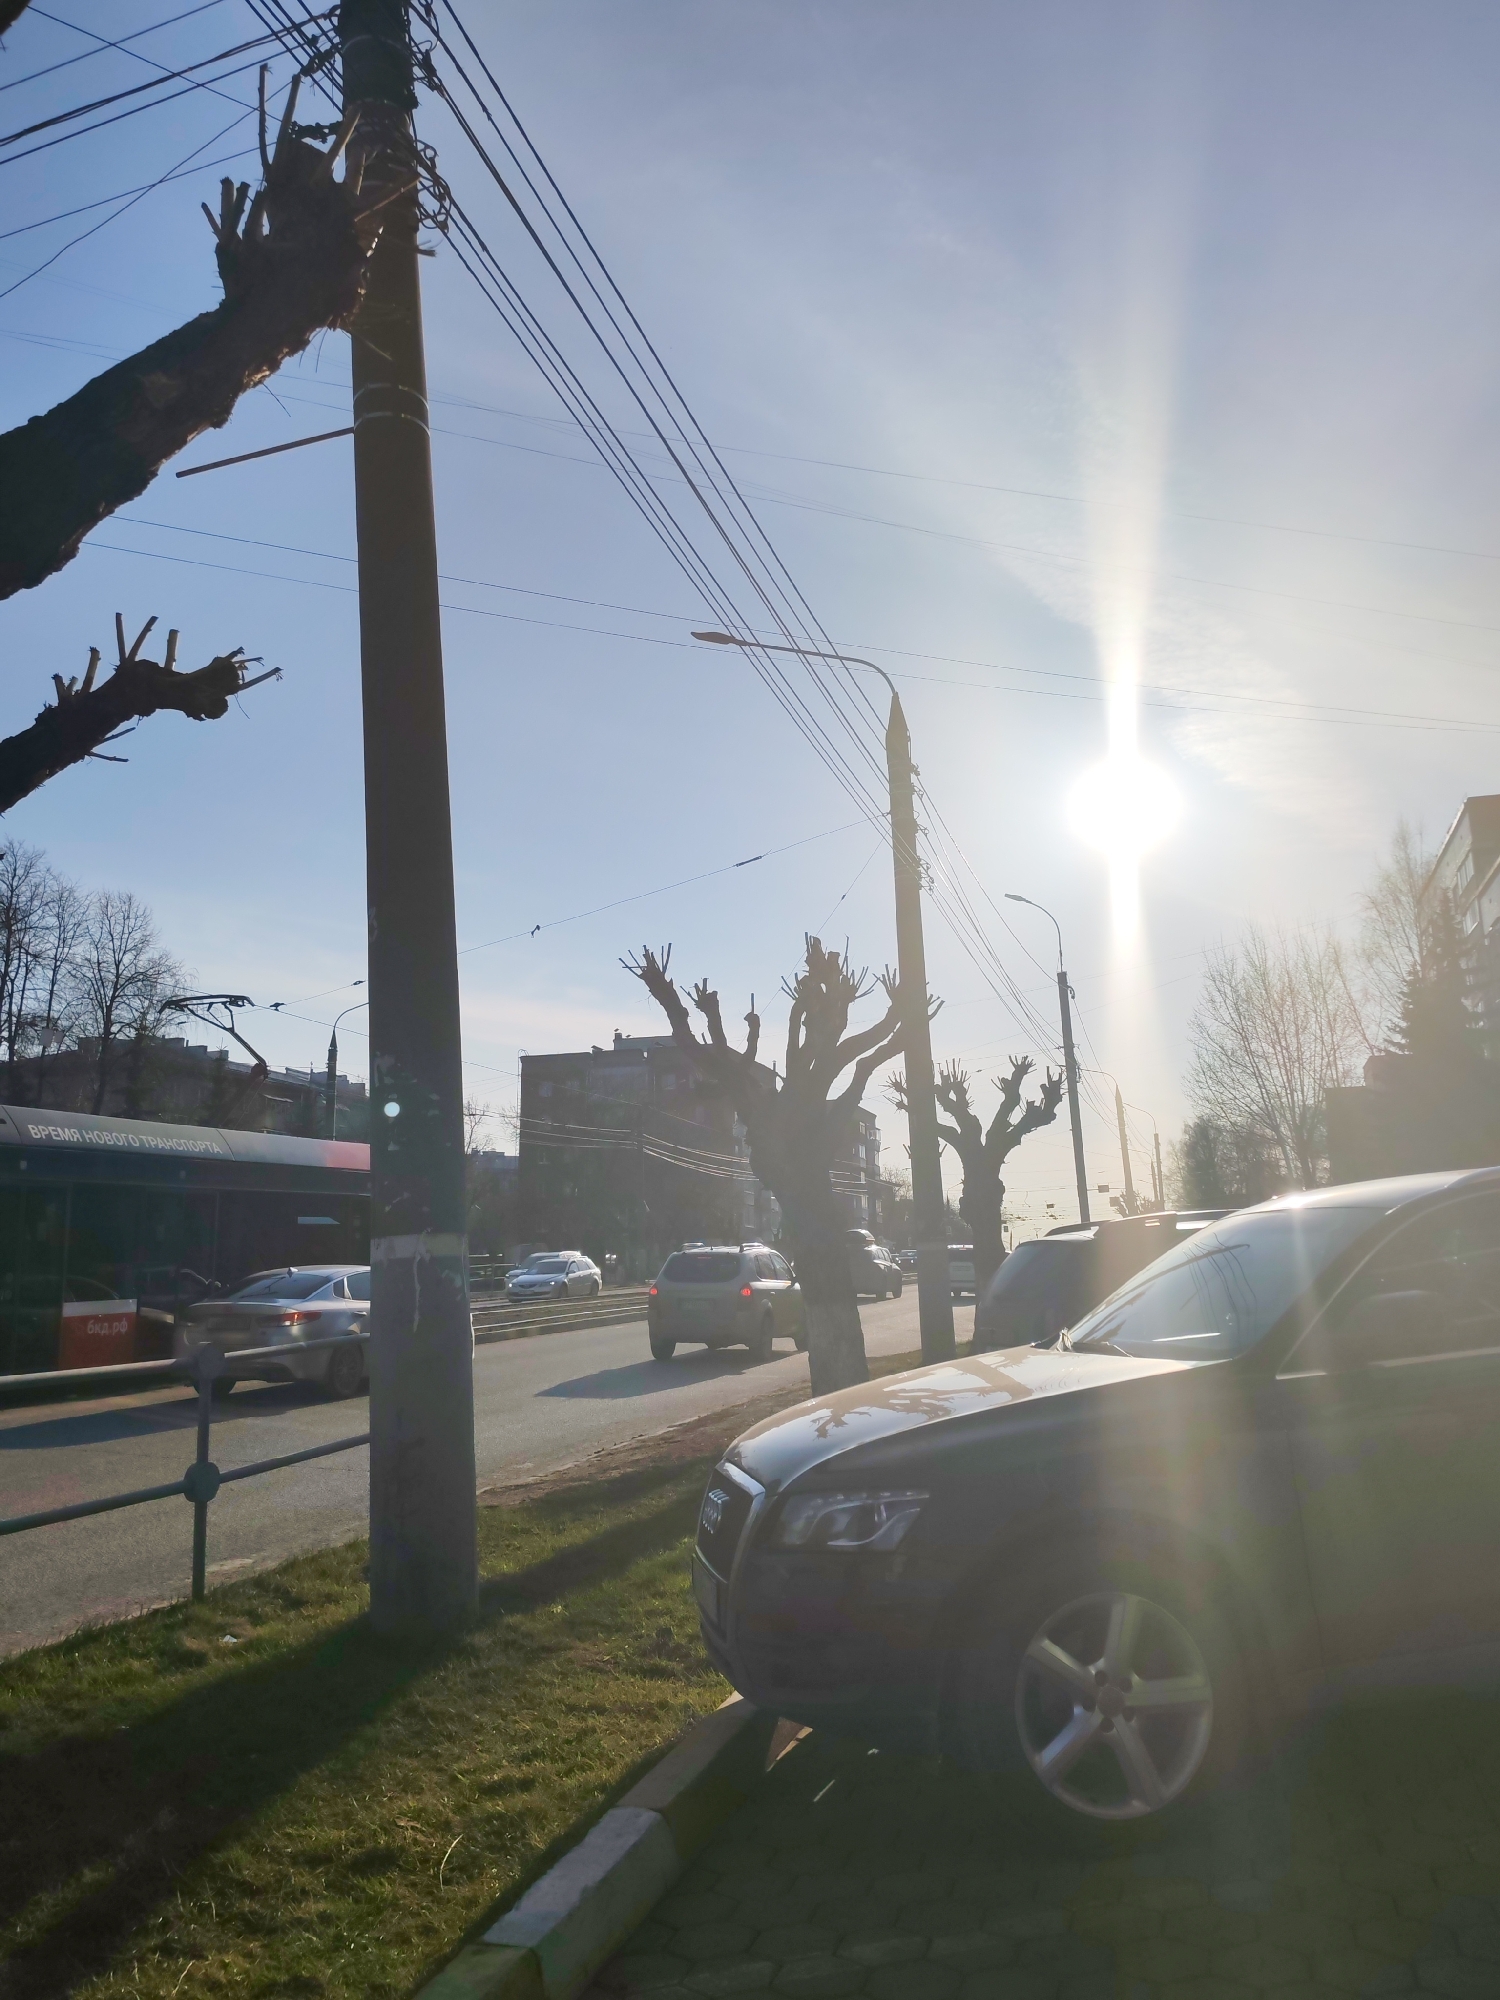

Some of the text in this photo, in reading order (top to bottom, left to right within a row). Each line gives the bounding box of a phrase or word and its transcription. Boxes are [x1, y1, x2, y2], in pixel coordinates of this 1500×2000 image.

[27, 1124, 223, 1154] ВРЕМЯ НОВОГО ТРАНСПОРТА
[87, 1317, 128, 1336] бкд.рф
